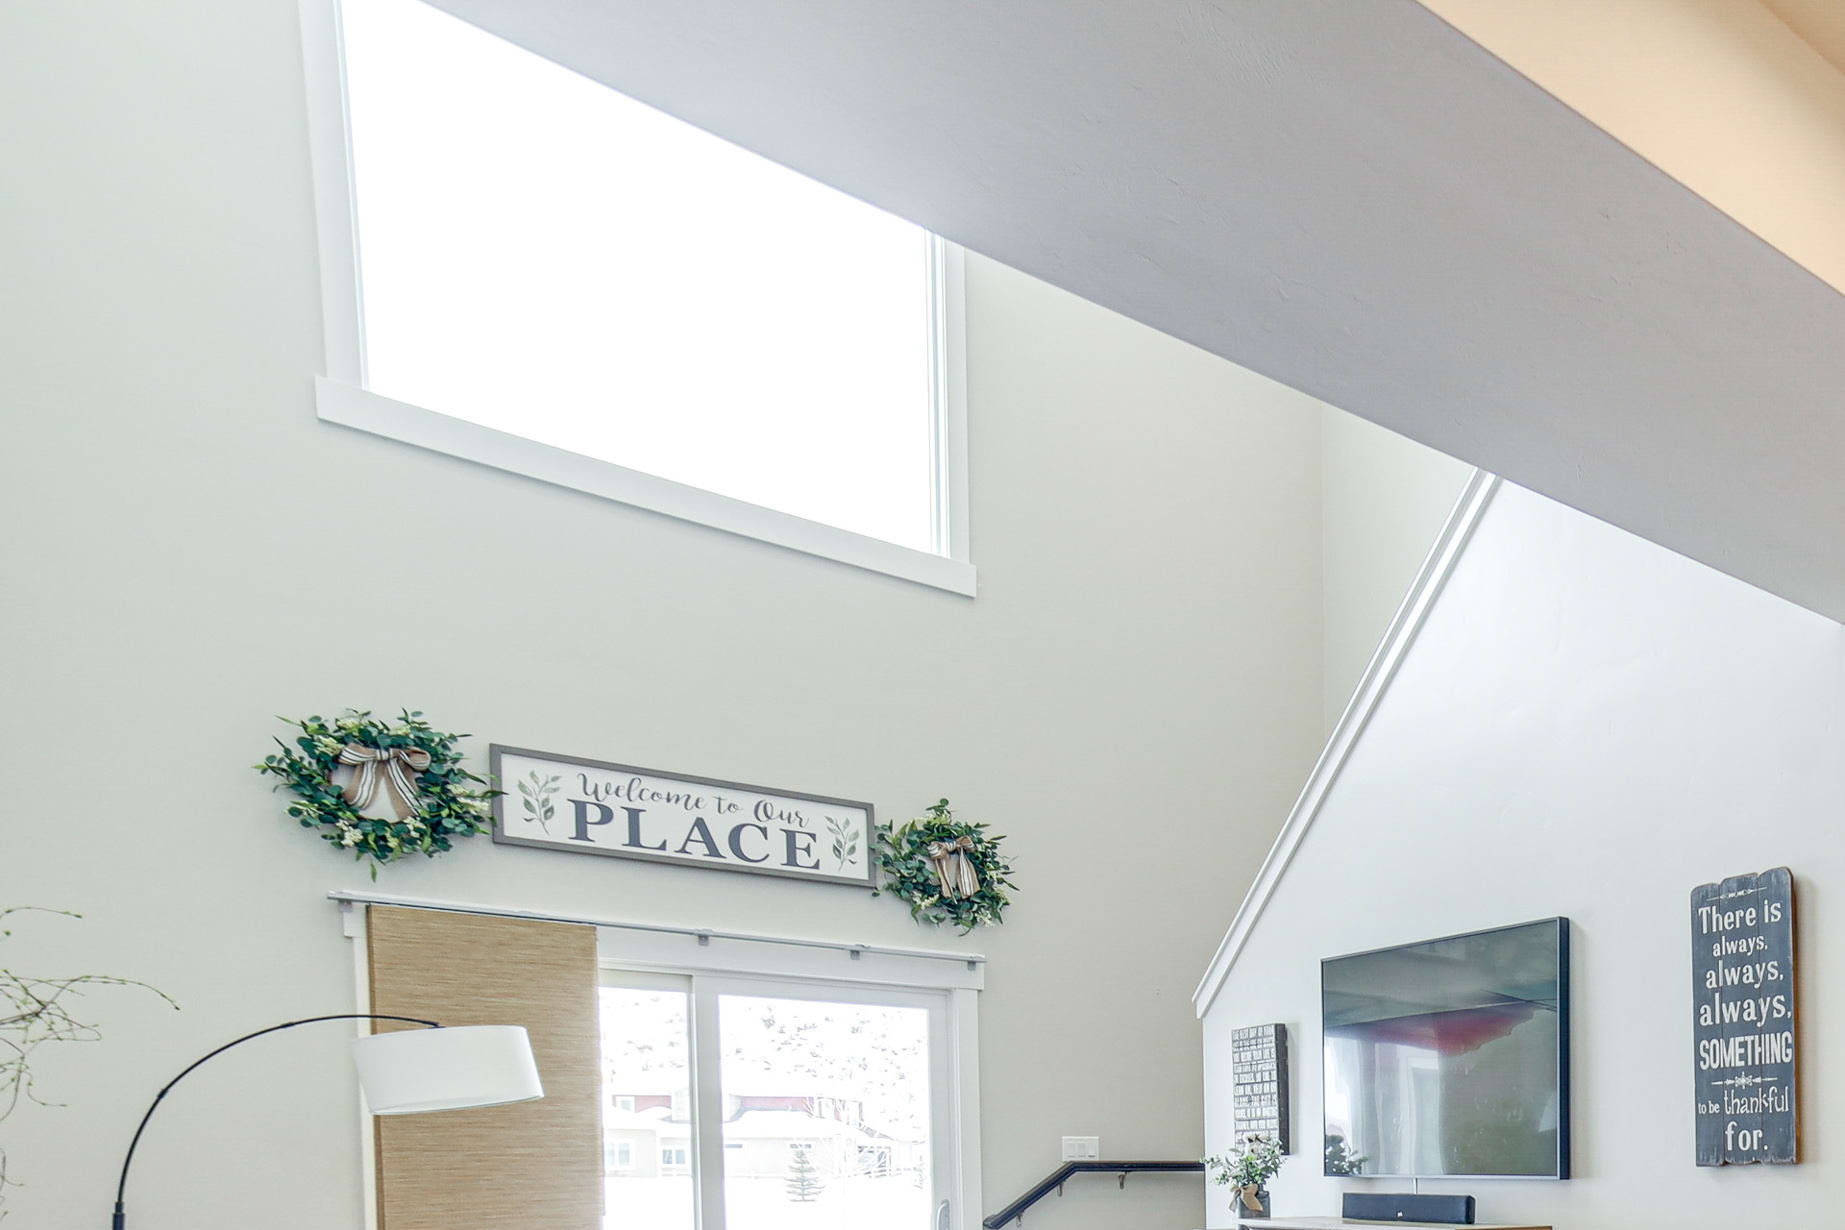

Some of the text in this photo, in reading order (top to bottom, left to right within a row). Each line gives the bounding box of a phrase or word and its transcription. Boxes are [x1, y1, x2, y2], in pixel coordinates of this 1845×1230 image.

[577, 772, 810, 828] Welcome to Our
[567, 798, 821, 870] PLACE
[1698, 899, 1782, 935] There is
[1705, 959, 1784, 989] always,
[1699, 991, 1792, 1028] always,
[1699, 1030, 1793, 1071] SOMETHING
[1697, 1085, 1790, 1115] to be thankful
[1724, 1120, 1769, 1152] for.
